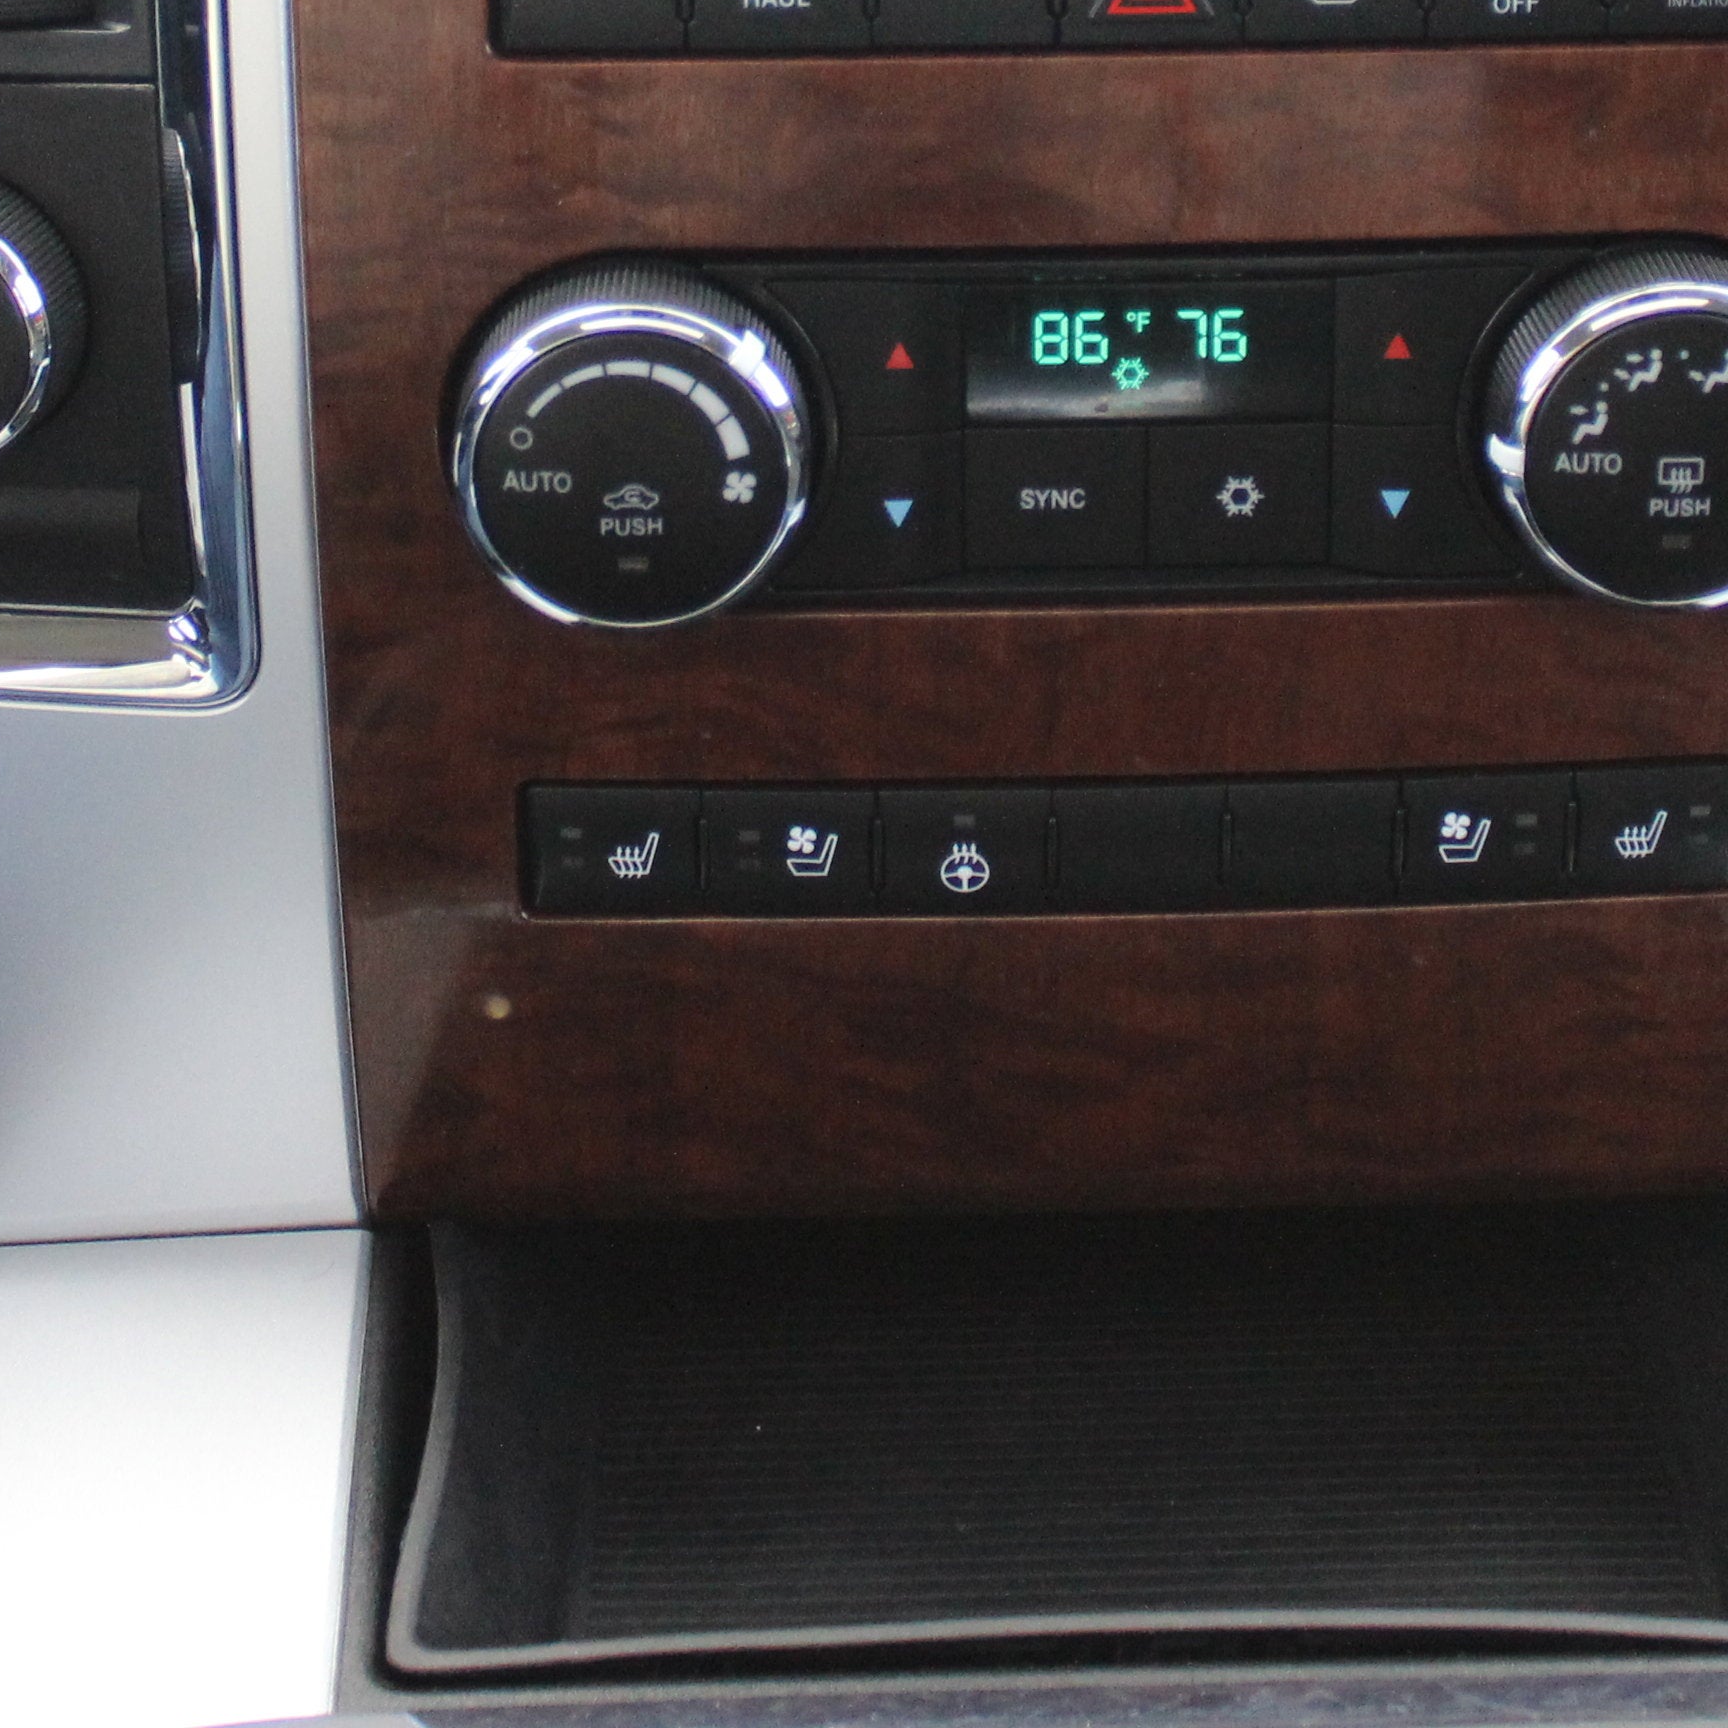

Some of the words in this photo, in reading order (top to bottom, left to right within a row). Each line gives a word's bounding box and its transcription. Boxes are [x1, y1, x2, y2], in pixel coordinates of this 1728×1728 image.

[1033, 310, 1110, 366] 86
[1175, 306, 1249, 363] 76
[1553, 452, 1623, 475] AUTO
[502, 470, 572, 495] AUTO
[1019, 489, 1087, 511] SYNC
[1649, 496, 1710, 518] PUSH
[599, 516, 664, 537] PUSH
